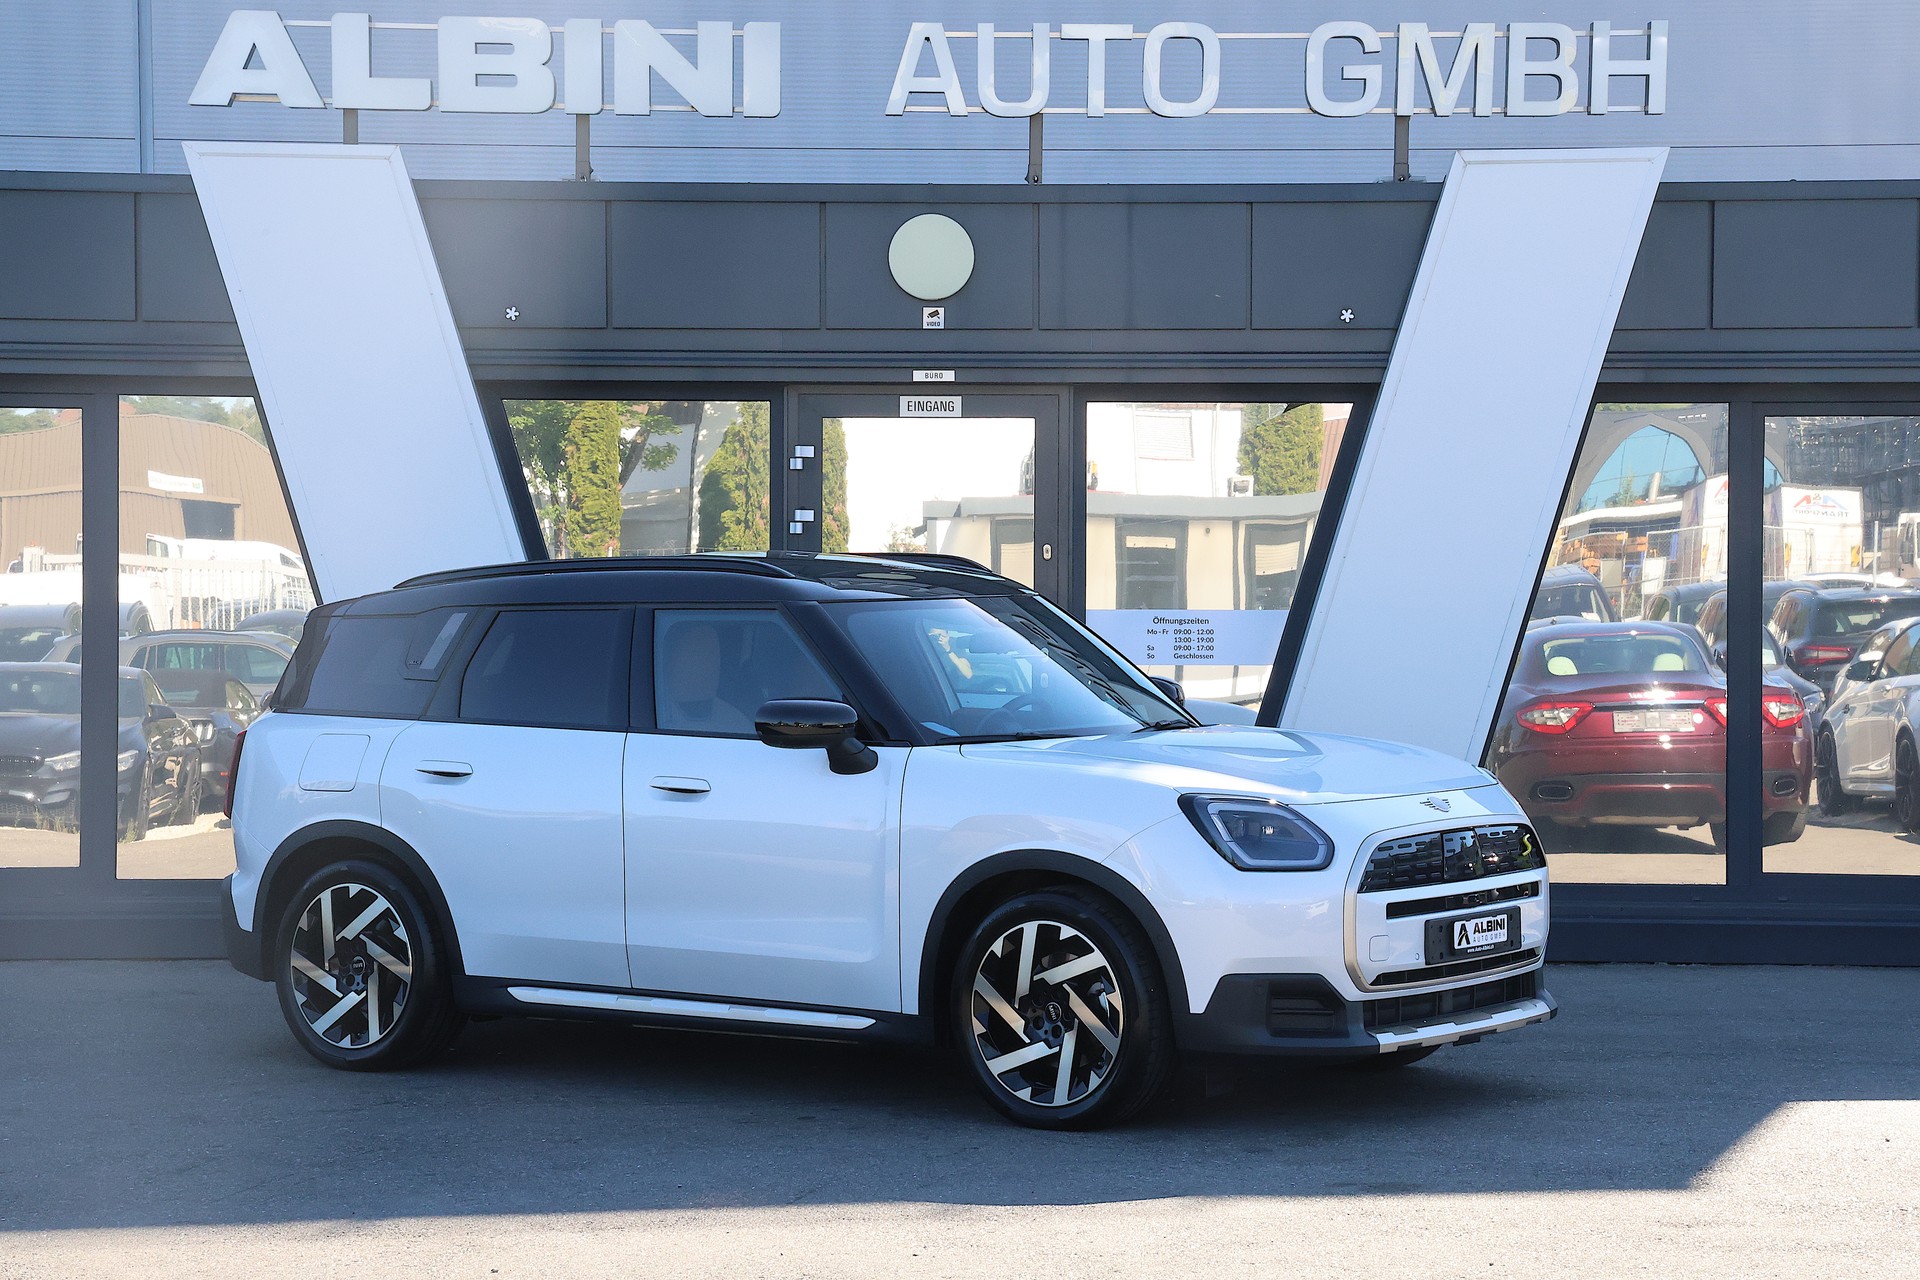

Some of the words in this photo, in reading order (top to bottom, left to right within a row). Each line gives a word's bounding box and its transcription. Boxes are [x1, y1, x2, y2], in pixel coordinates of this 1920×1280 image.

[188, 9, 782, 118] ALBINI
[885, 21, 1222, 118] AUTO
[1304, 19, 1670, 118] GMBH
[907, 400, 955, 412] EINGANG
[1152, 616, 1210, 626] Öffnungszeiten
[1146, 652, 1156, 660] So
[1173, 652, 1215, 660] Geschlossen
[1473, 918, 1505, 934] ALBINI
[1473, 935, 1489, 943] AUTO
